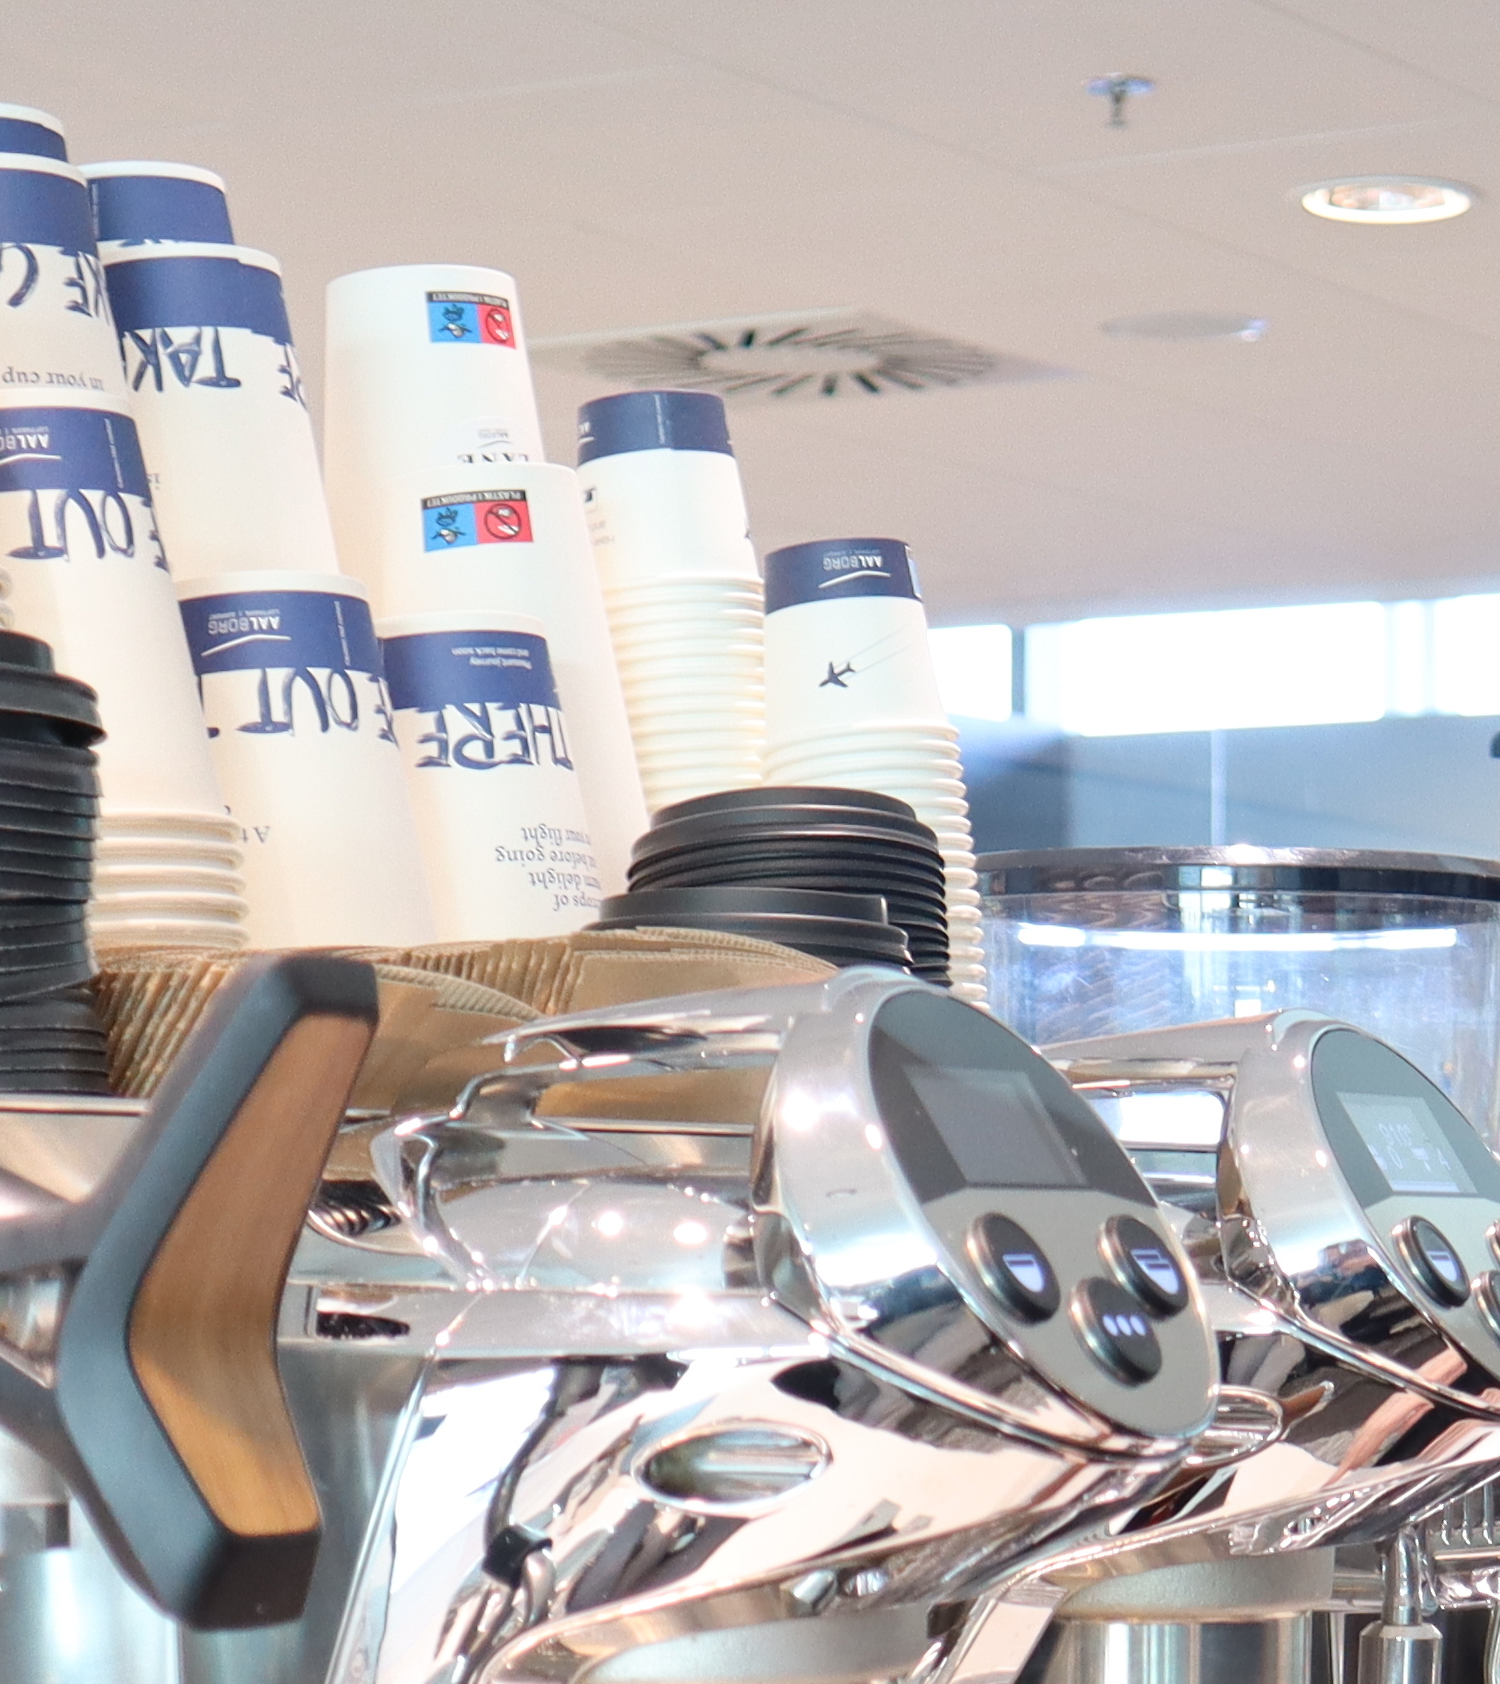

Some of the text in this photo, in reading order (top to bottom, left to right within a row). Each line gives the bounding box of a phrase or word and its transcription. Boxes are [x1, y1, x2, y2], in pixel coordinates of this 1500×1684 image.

[1, 366, 41, 388] cup
[46, 371, 87, 392] your
[4, 489, 135, 562] OUT
[822, 554, 883, 571] AALBORG
[207, 616, 280, 636] AALBORG
[235, 667, 359, 738] OUT
[521, 824, 563, 846] flight
[494, 844, 546, 867] going
[527, 868, 581, 890] delight
[551, 893, 569, 912] of
